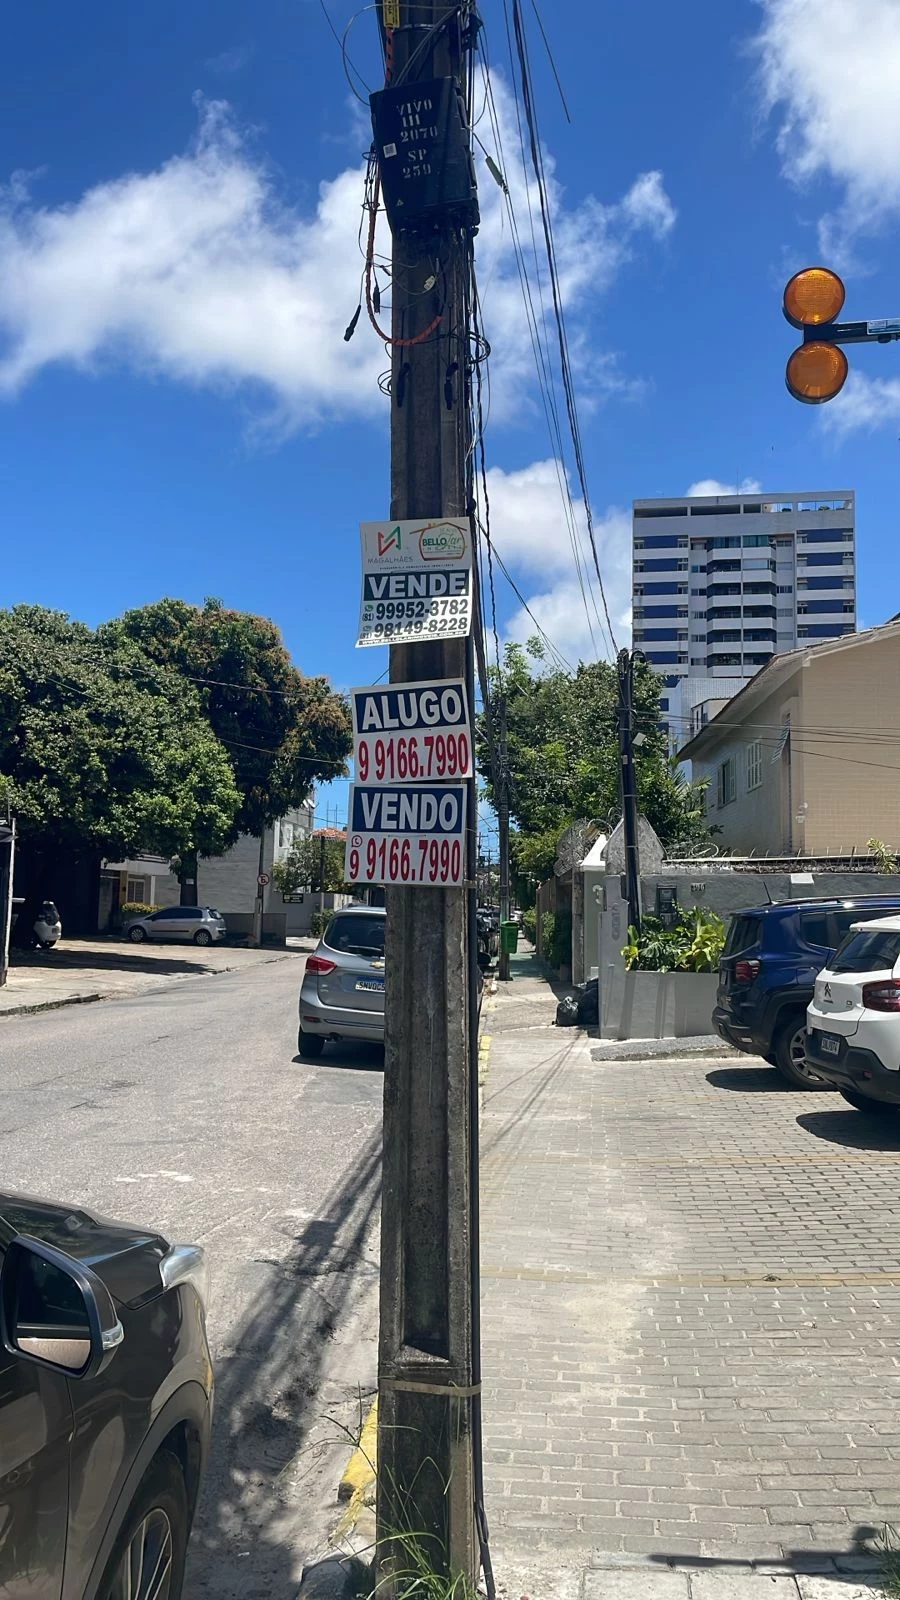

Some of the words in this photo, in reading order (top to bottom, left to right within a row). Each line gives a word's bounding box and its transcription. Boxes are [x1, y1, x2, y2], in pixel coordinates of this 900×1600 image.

[396, 99, 432, 115] VIVO
[400, 126, 438, 142] 2070
[408, 148, 427, 162] SP
[422, 537, 447, 547] BELLO
[368, 572, 466, 599] VENDE
[376, 599, 468, 620] 99952-3782
[374, 617, 468, 638] 98149-8228
[362, 688, 463, 731] ALUGO
[358, 740, 369, 782] 9
[375, 732, 469, 781] 9166.7990
[360, 792, 459, 831] VENDO
[349, 849, 360, 880] 9
[366, 837, 461, 883] 9166.7990
